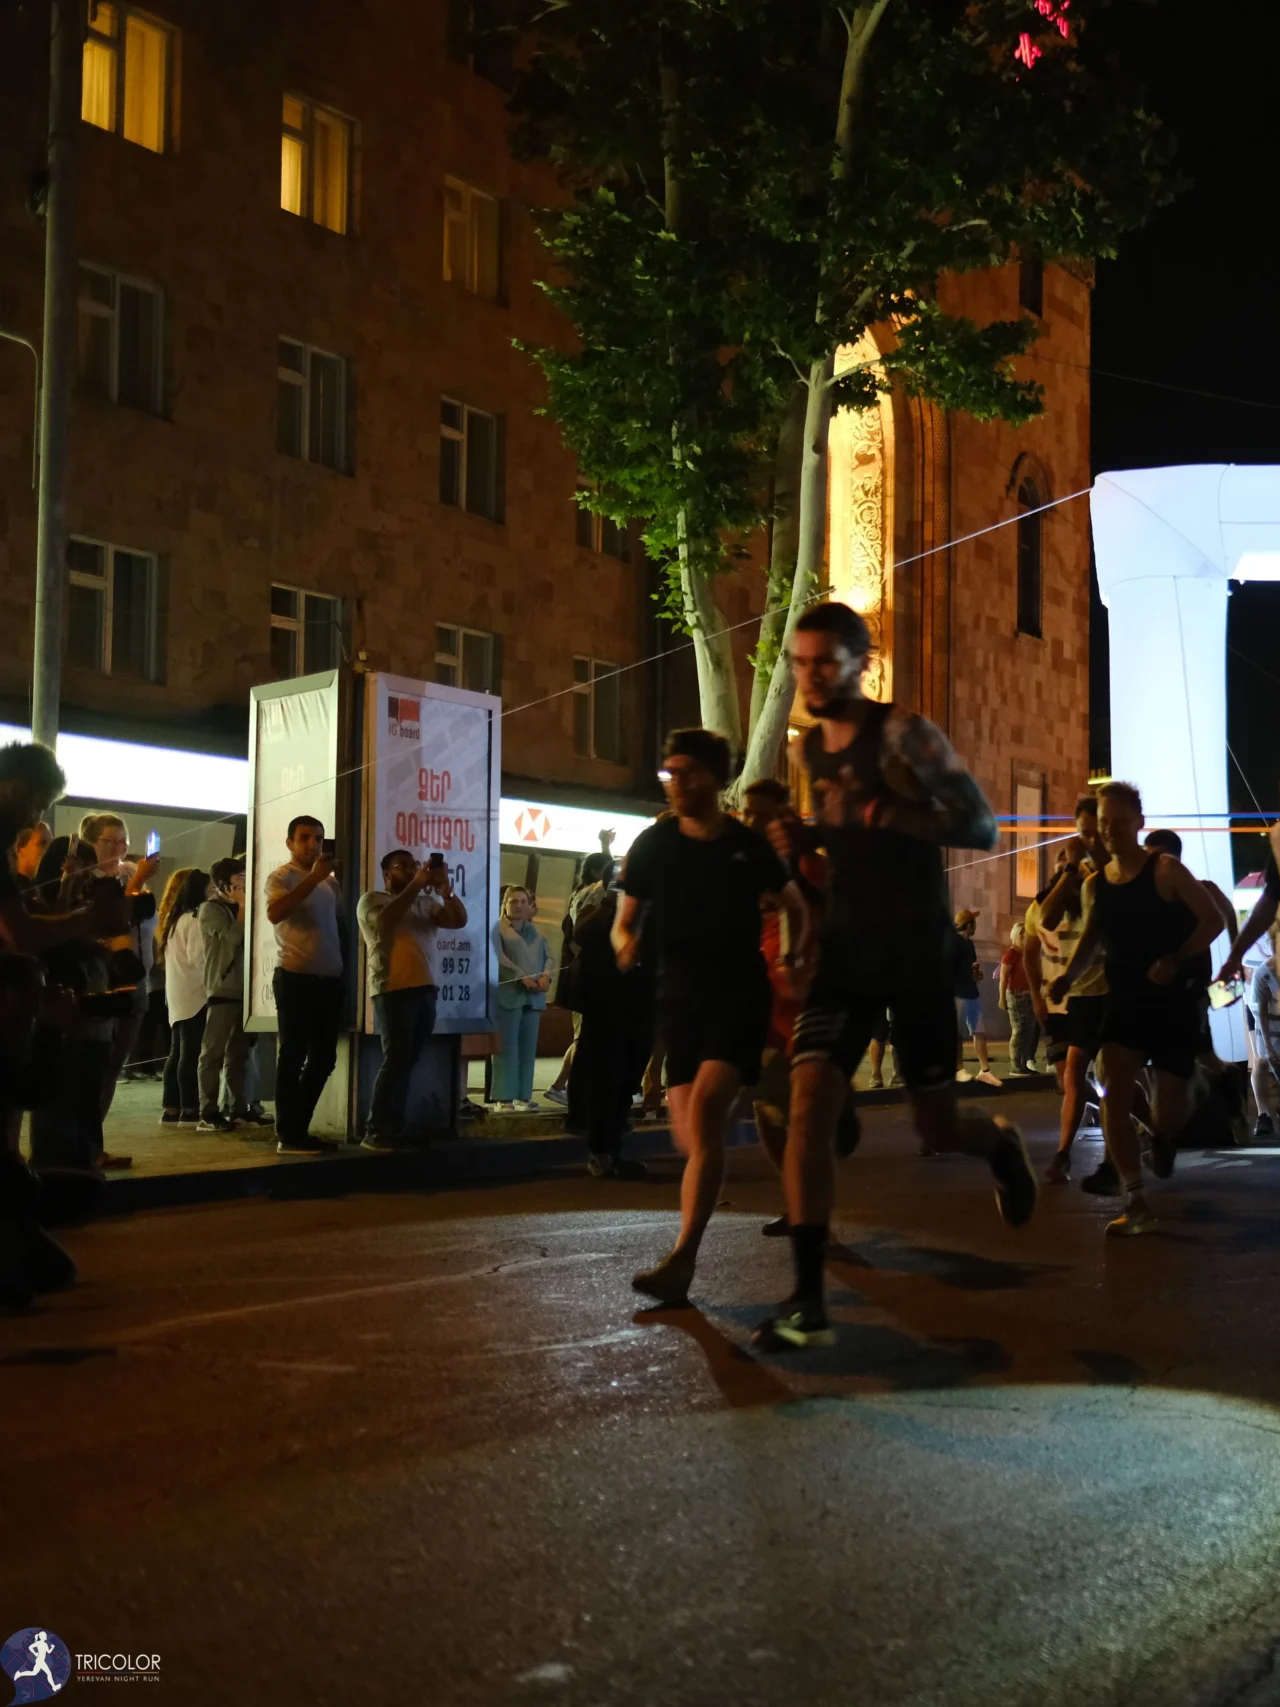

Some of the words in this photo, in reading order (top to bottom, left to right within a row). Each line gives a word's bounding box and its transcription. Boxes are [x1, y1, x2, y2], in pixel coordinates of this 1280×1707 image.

[400, 725, 420, 740] board
[437, 938, 471, 952] oard.am
[442, 957, 454, 975] 99
[458, 958, 470, 975] 57
[442, 985, 454, 1001] 01
[458, 985, 471, 1001] 28
